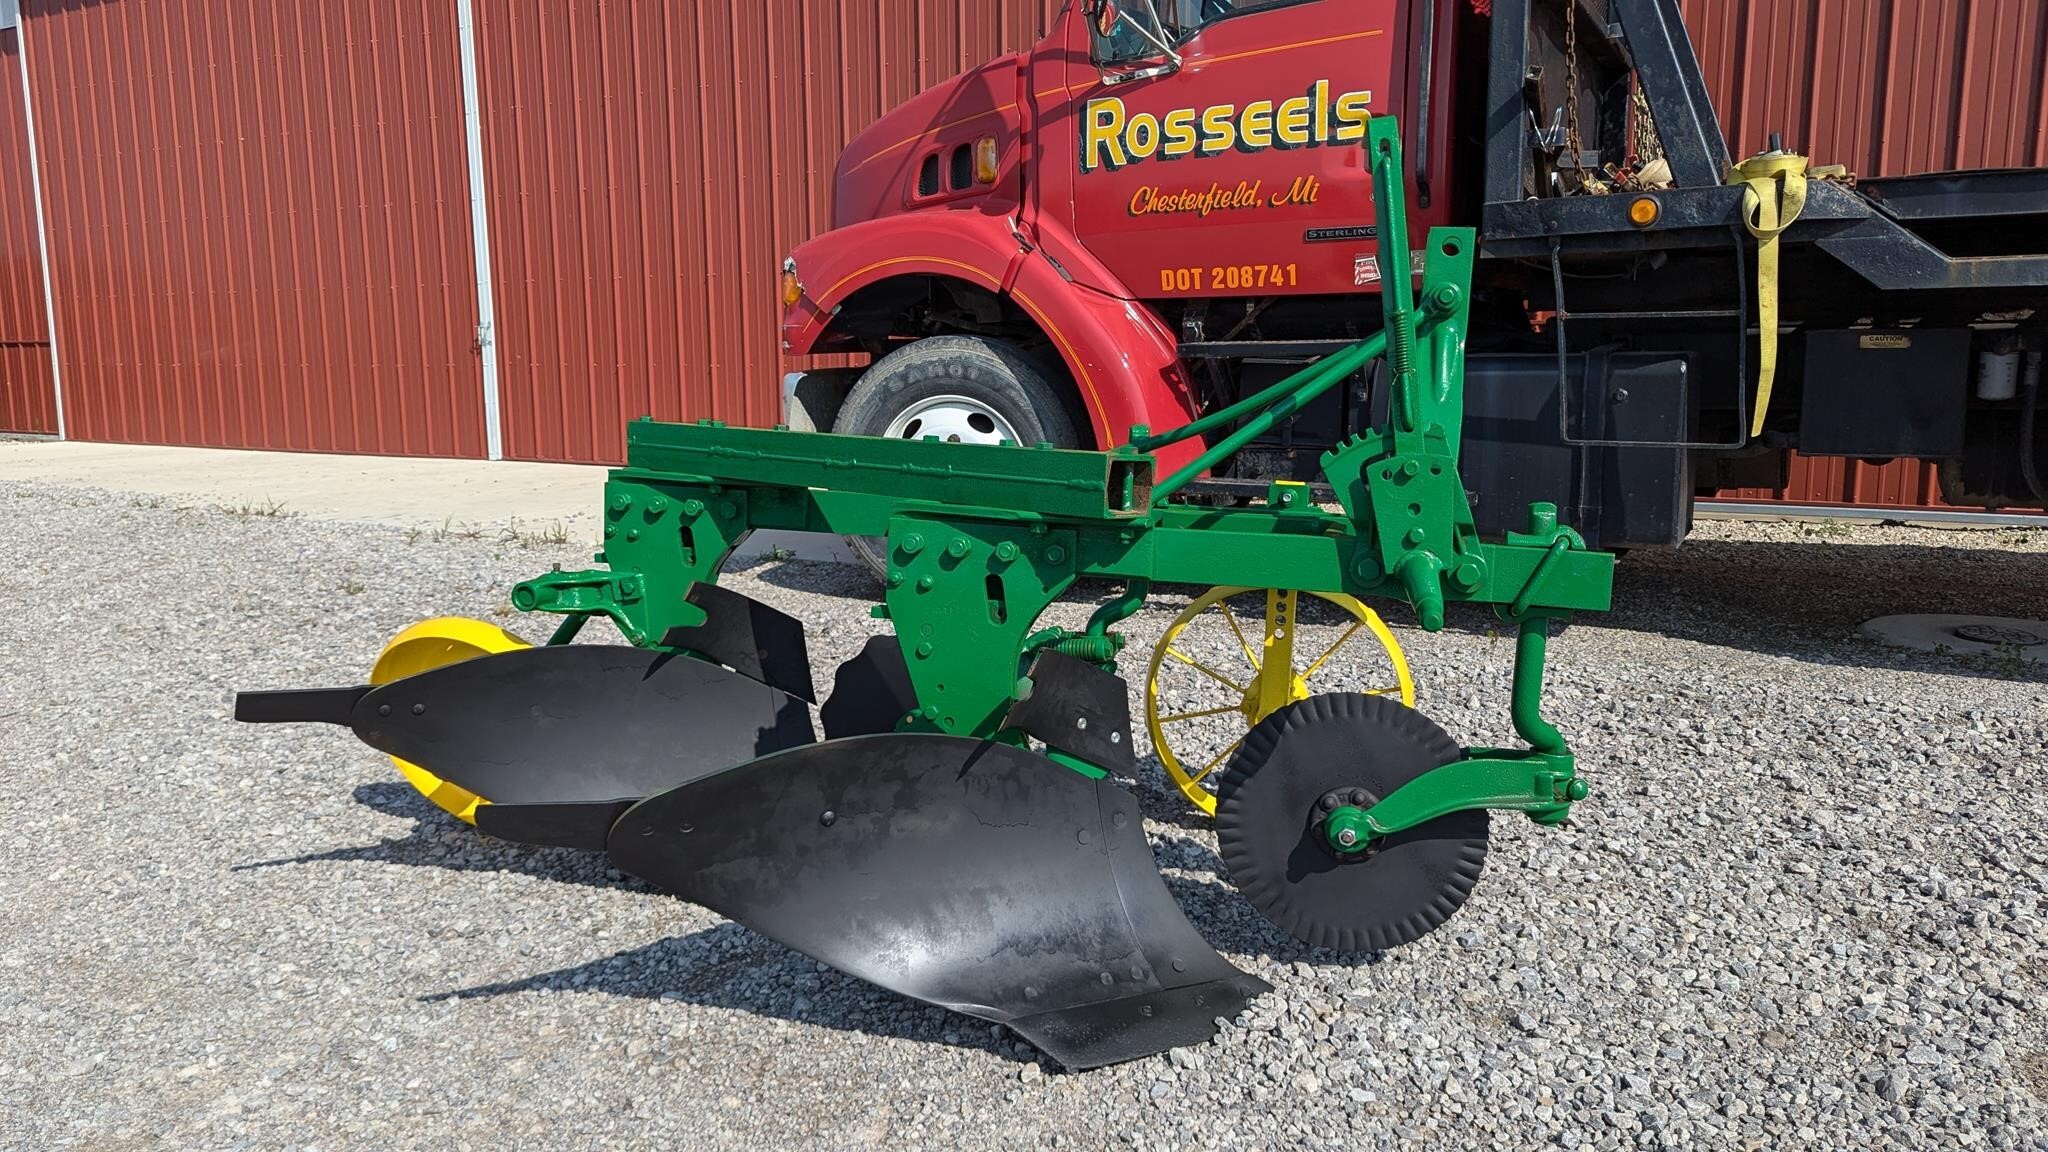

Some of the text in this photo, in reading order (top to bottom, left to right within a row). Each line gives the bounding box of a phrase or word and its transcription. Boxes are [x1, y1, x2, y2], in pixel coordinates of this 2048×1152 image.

[1084, 79, 1372, 170] Rosseels
[1129, 174, 1321, 217] Chesterfield, Mi
[1308, 227, 1377, 238] STERLING
[1160, 263, 1297, 291] DOT 208741
